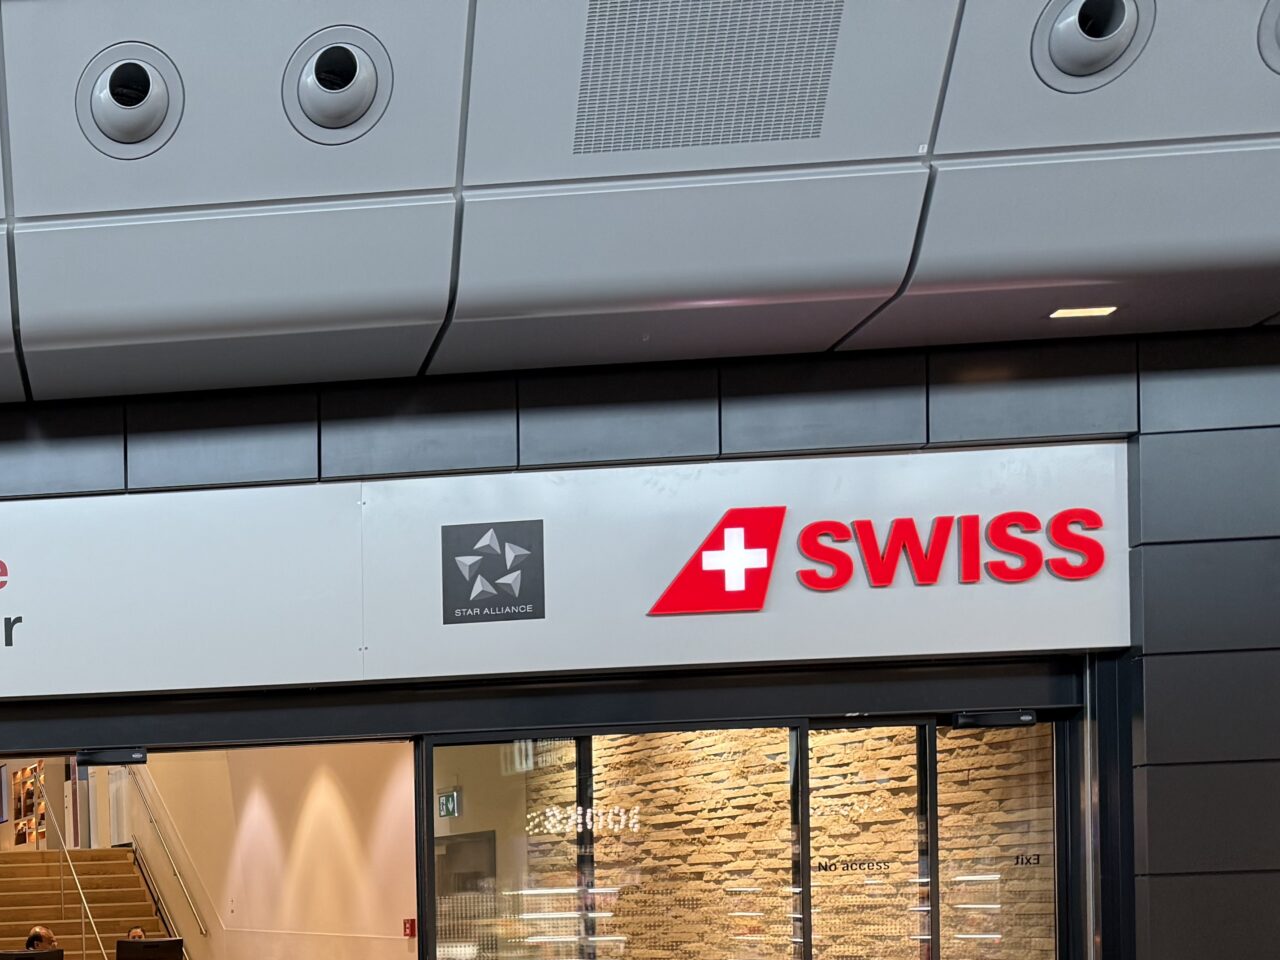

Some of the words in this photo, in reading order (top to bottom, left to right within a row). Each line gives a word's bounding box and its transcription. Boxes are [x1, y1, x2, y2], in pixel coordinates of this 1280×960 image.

[795, 507, 1106, 591] SWISS
[454, 608, 480, 617] STAR
[483, 604, 534, 615] ALLIANCE
[818, 861, 837, 872] No
[842, 861, 890, 872] access
